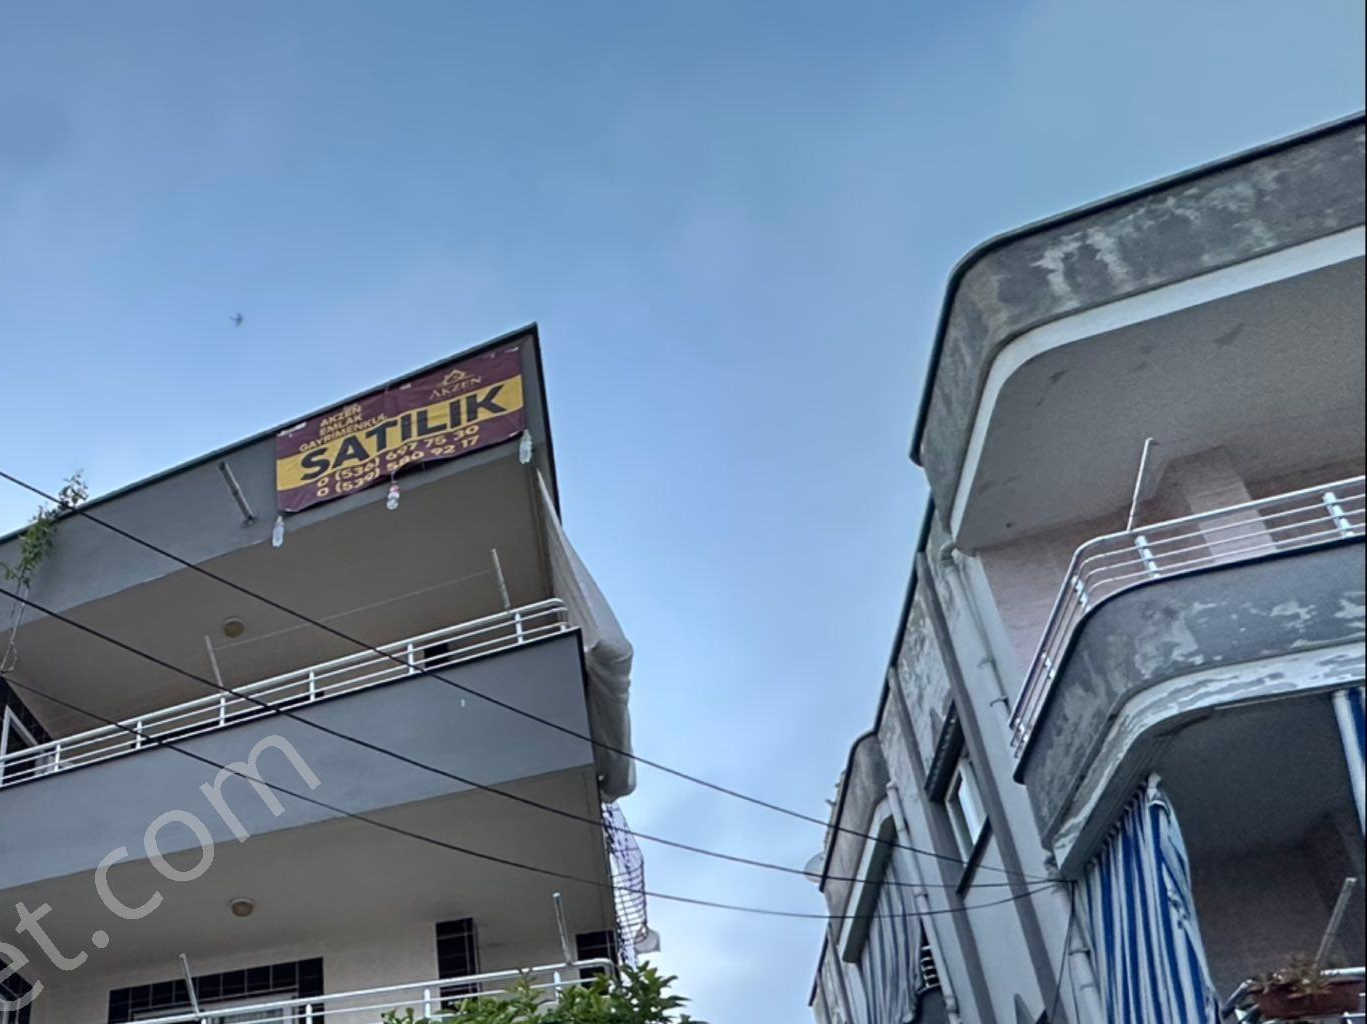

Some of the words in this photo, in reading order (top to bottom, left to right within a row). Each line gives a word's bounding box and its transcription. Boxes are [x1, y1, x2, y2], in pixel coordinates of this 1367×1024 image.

[429, 376, 482, 400] AKZEN
[300, 384, 508, 480] SATILIK
[319, 414, 362, 436] EMLAK
[320, 404, 362, 426] AKZEN
[316, 476, 329, 487] 0
[424, 435, 447, 448] 75
[453, 425, 479, 441] 30
[316, 487, 329, 497] 0
[461, 435, 479, 448] 17
